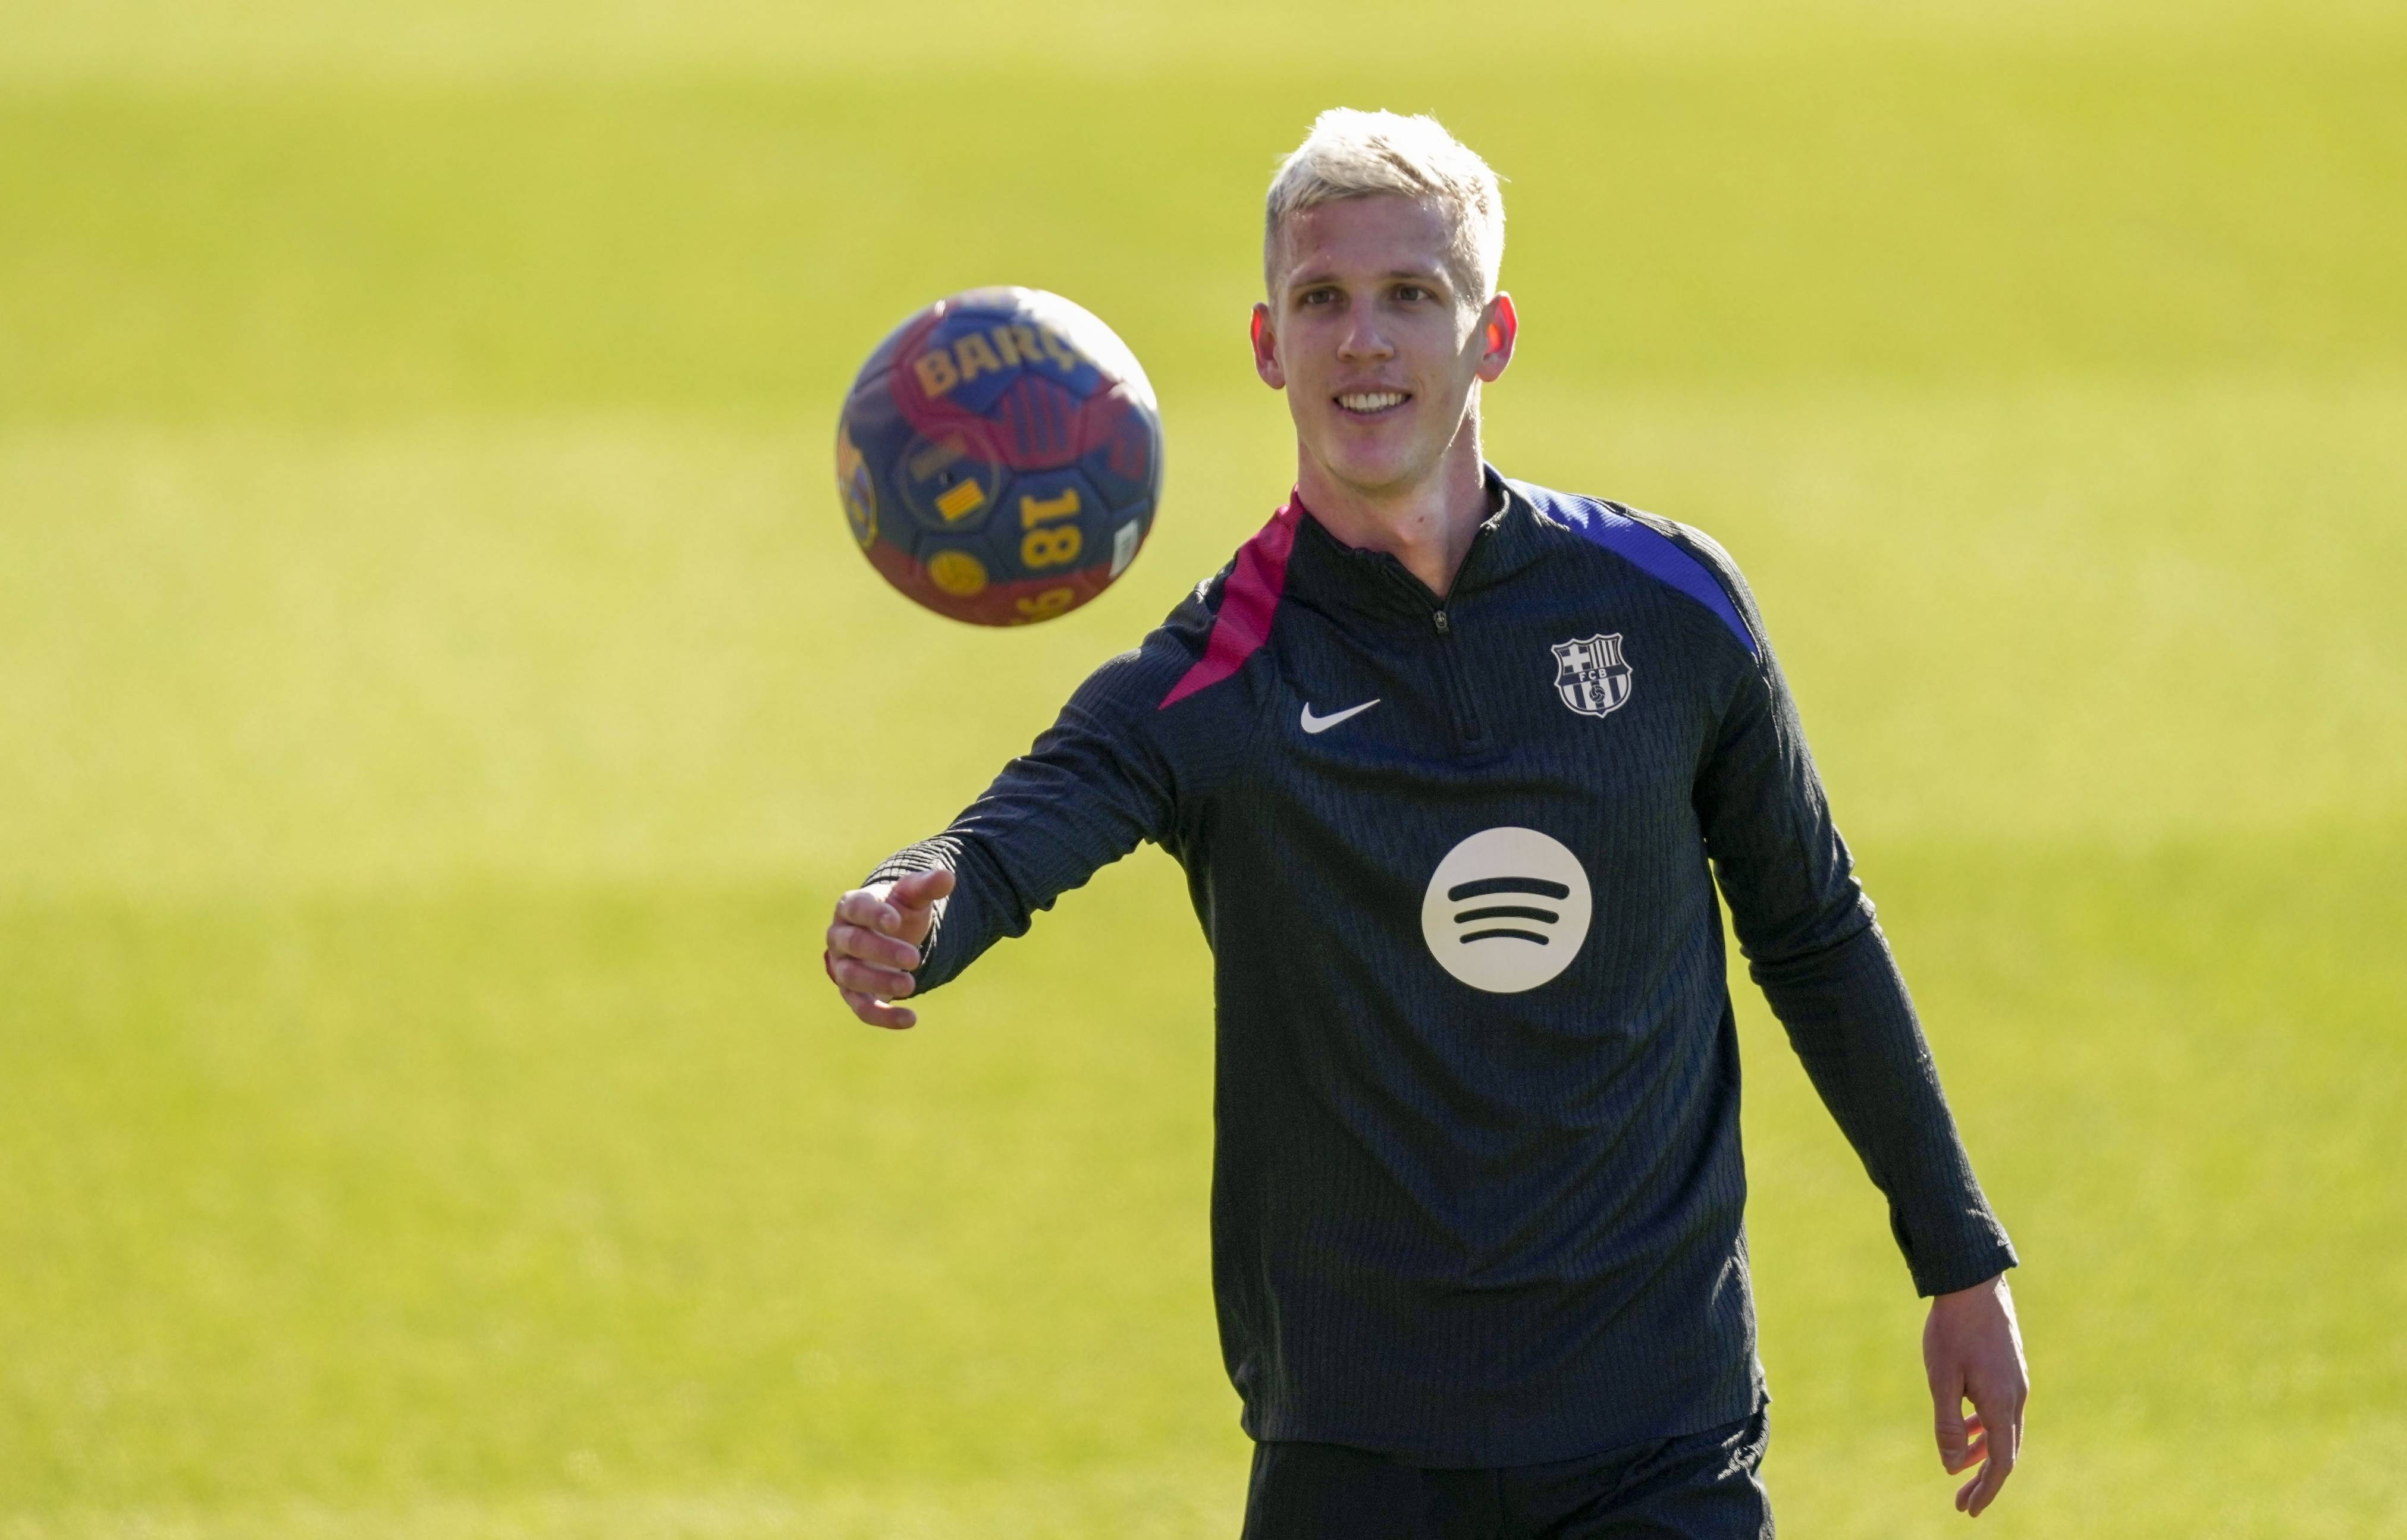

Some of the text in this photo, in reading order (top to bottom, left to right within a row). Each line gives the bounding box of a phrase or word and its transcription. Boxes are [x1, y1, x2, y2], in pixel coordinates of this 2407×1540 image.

[914, 325, 1090, 397] BARÇ
[1019, 488, 1082, 569] 18
[1578, 668, 1607, 682] FCB
